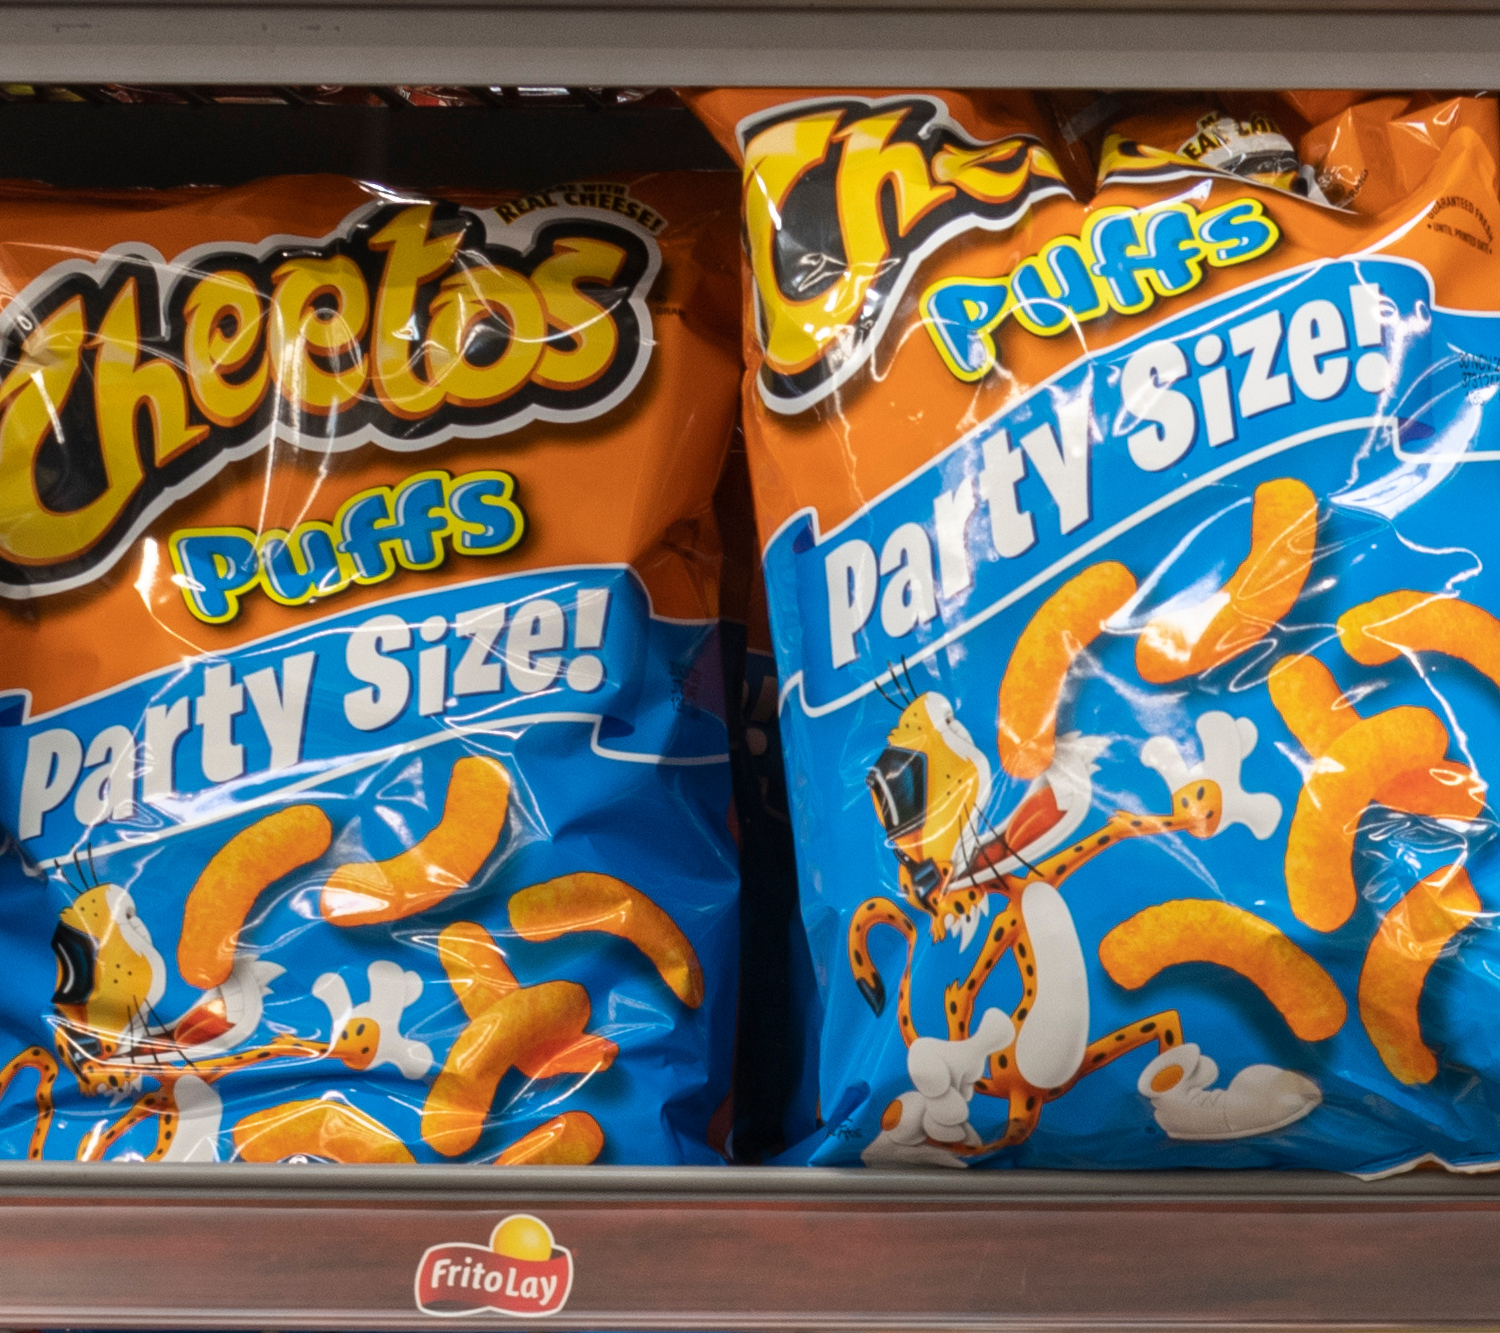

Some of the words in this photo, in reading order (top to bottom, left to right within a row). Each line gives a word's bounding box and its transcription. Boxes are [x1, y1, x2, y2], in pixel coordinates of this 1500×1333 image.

[494, 191, 558, 225] REAL
[825, 404, 1091, 670] Party
[1120, 283, 1397, 472] Size!
[20, 648, 316, 840] Party
[343, 589, 609, 731] Size!
